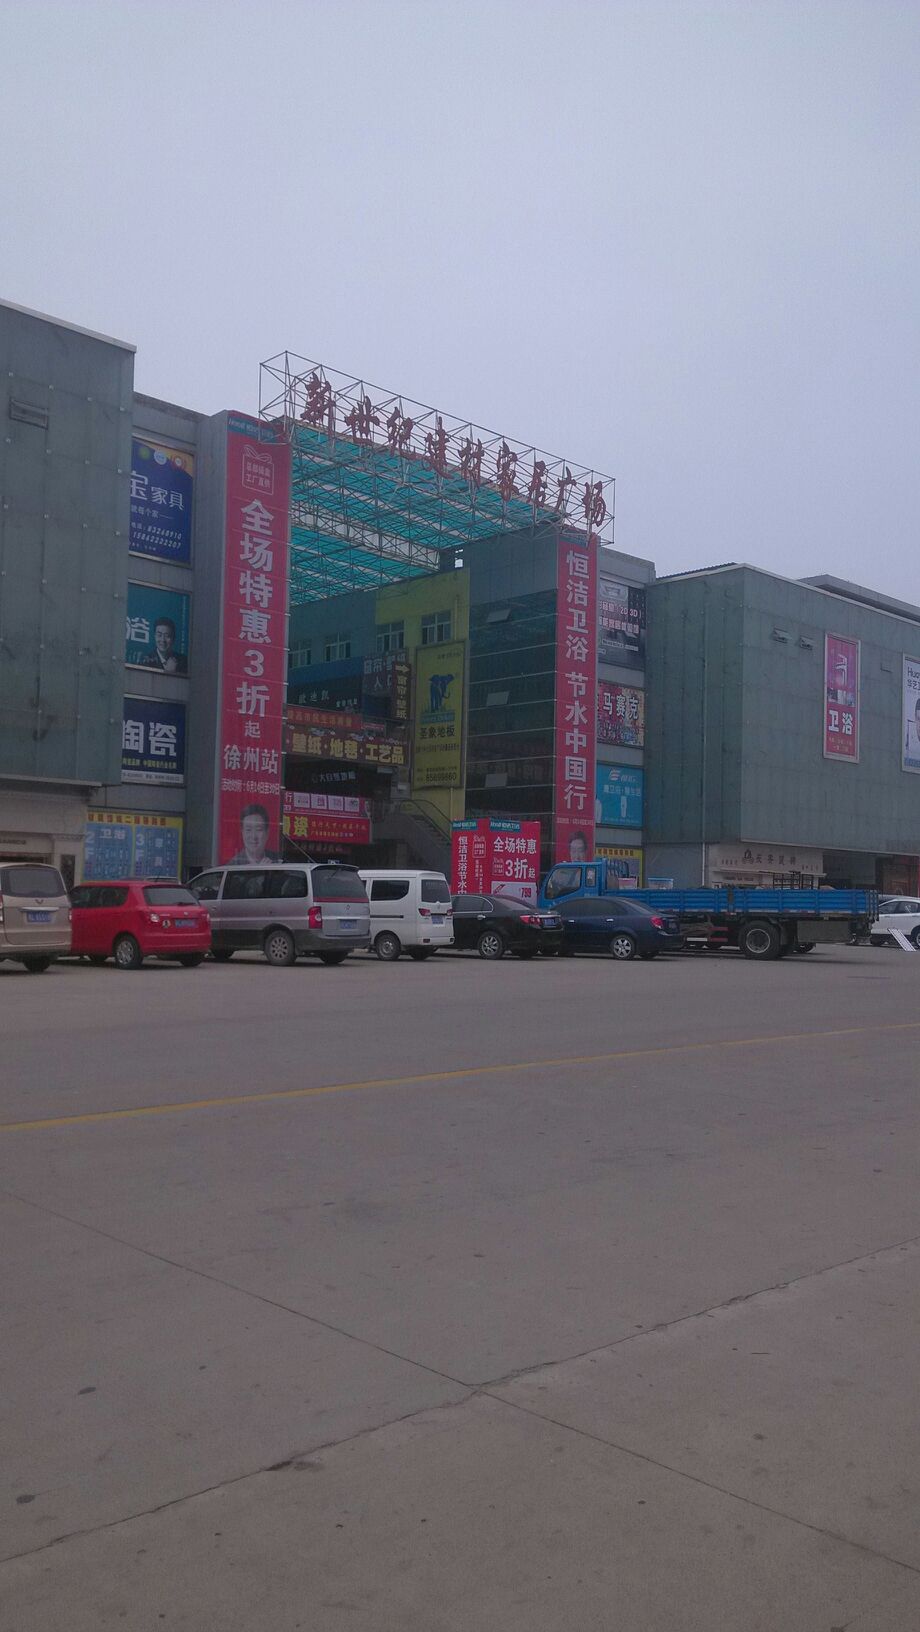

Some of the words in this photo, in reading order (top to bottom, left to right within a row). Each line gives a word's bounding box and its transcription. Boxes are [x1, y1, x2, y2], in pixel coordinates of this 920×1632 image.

[565, 550, 590, 662] 恒洁卫浴
[603, 692, 639, 720] 马赛克
[122, 719, 177, 756] 陶瓷
[828, 709, 853, 735] 卫浴
[563, 671, 589, 810] 节水中国行
[223, 744, 279, 775] 徐州站
[493, 836, 537, 855] 全场特惠
